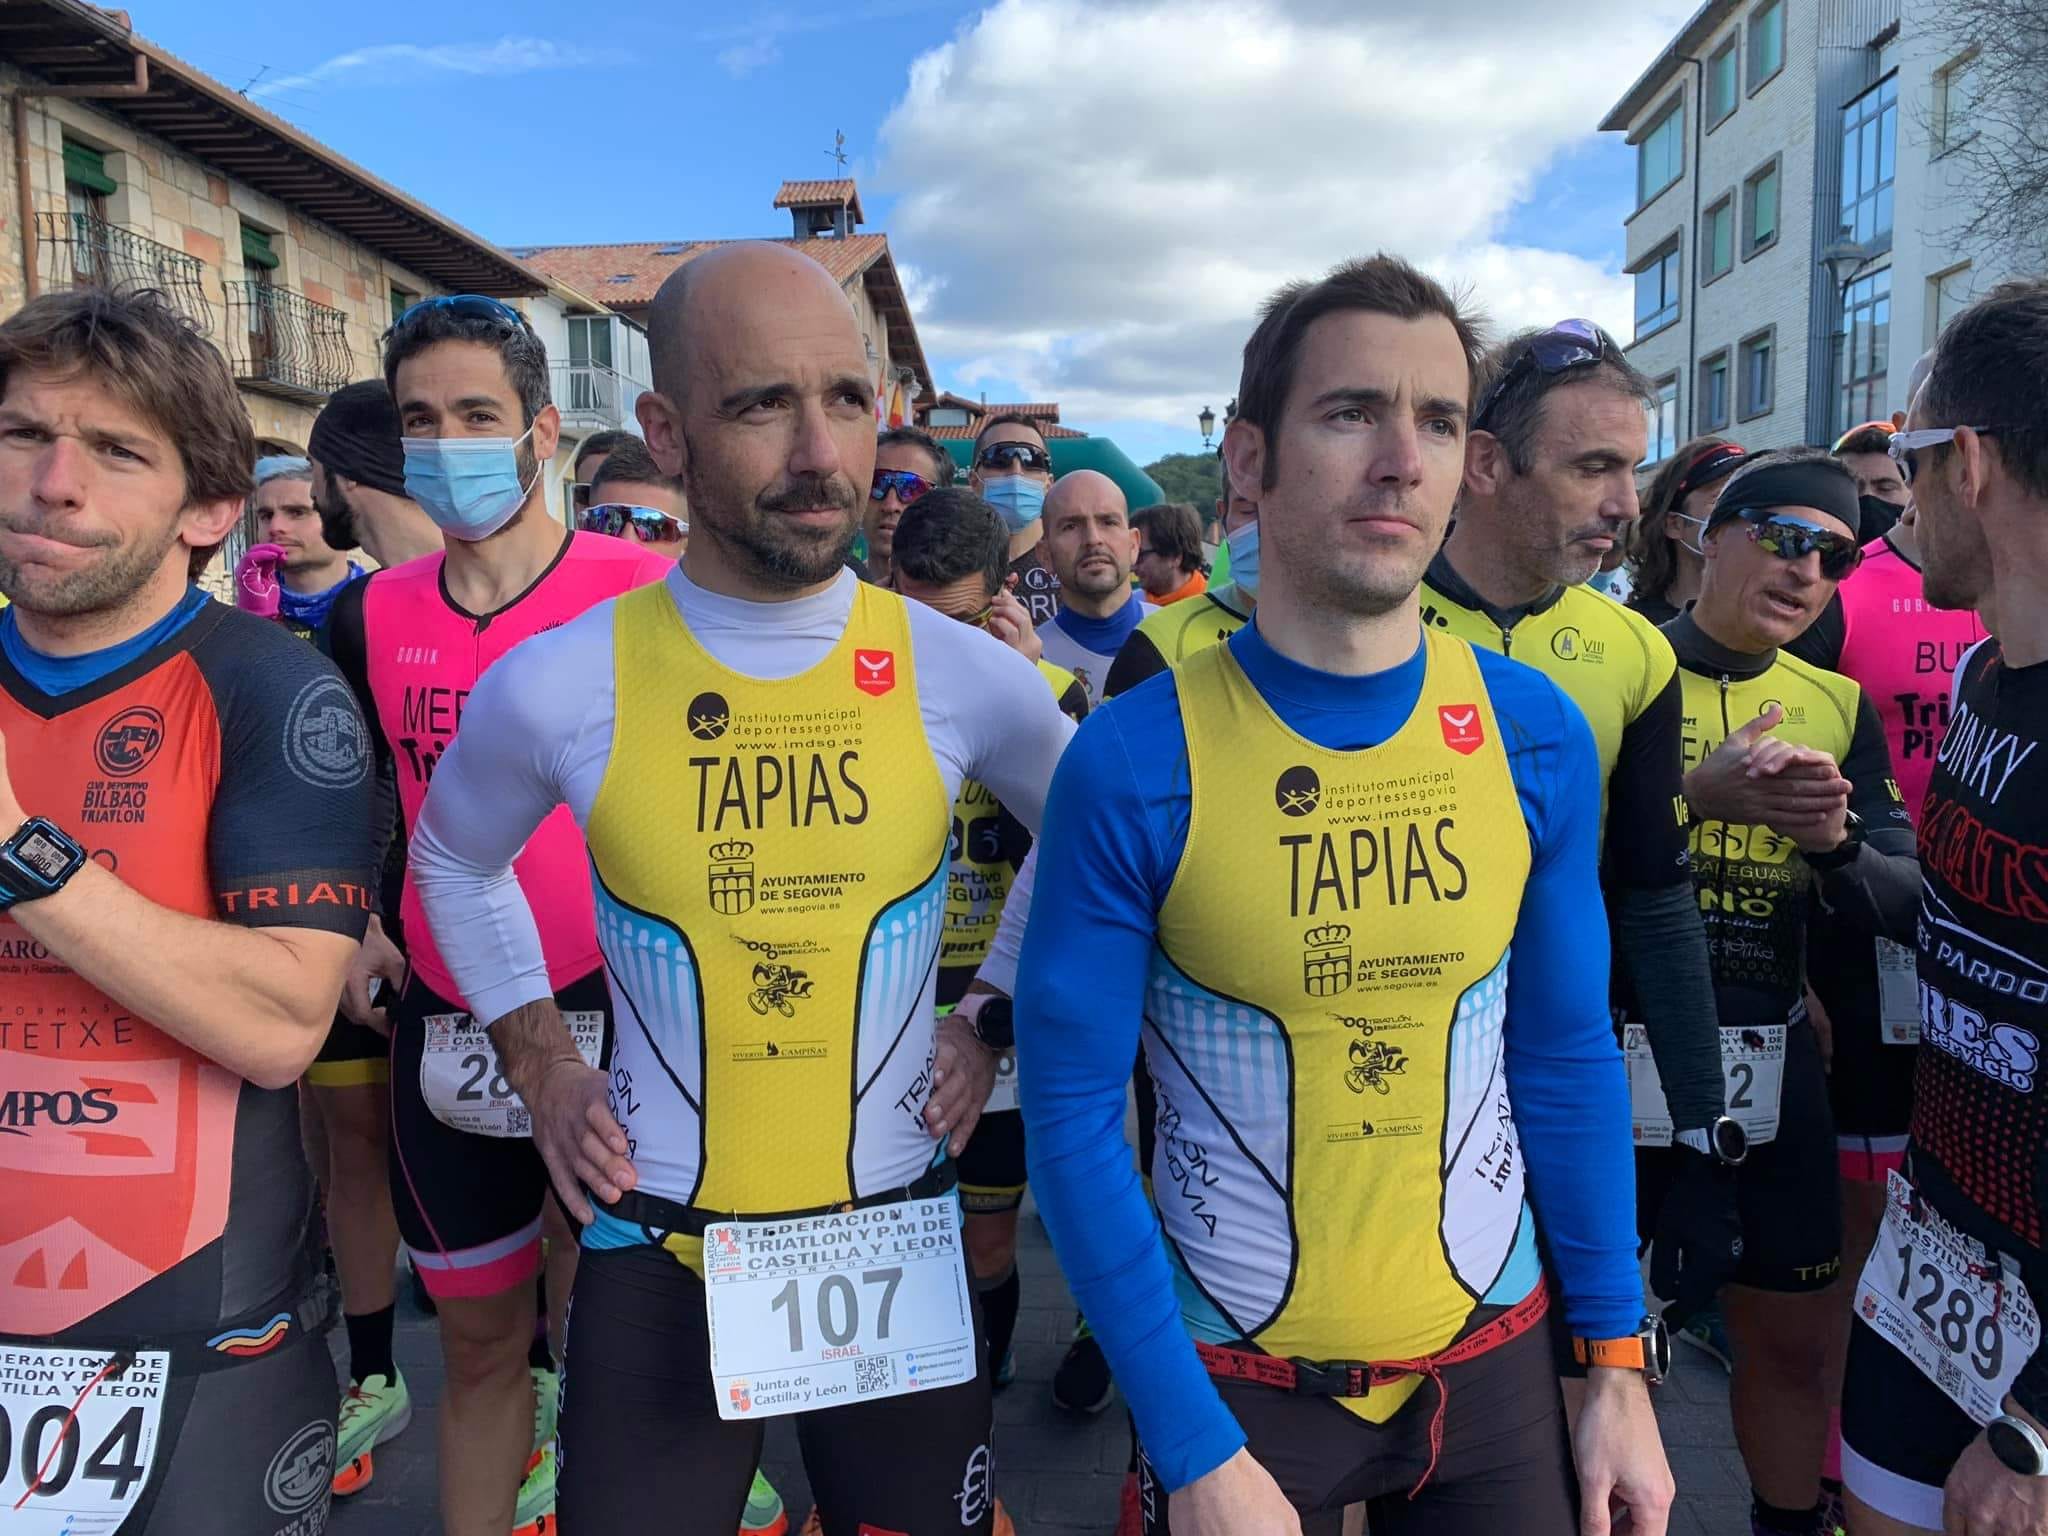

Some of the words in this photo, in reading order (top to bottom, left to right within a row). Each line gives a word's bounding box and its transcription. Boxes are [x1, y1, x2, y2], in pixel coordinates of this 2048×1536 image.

[1915, 641, 1976, 673] BU
[733, 722, 863, 737] deportessegovia
[735, 737, 863, 751] www.imdsg.es
[1902, 730, 1945, 760] Pi
[84, 790, 147, 808] BILBAO
[689, 750, 869, 832] TAPIAS
[1325, 785, 1457, 809] deportessegovia
[81, 810, 145, 823] TRIATLON
[1327, 802, 1458, 825] www.imdsg.es
[1279, 817, 1468, 917] TAPIAS
[760, 873, 866, 887] AYUNTAMIENTO
[760, 889, 779, 901] DE
[783, 887, 843, 899] SEGOVIA
[760, 902, 841, 914] www.segovia.es
[0, 939, 48, 959] ARO
[1358, 951, 1465, 970] AYUNTAMIENTO
[1357, 972, 1375, 981] DE
[1381, 967, 1442, 979] SEGOVIA
[1357, 980, 1438, 993] www.segovia.es
[894, 1048, 935, 1113] TRIA
[747, 1208, 903, 1239] FEDERACION
[921, 1202, 950, 1216] DE
[745, 1230, 857, 1253] TRIATLON
[858, 1228, 870, 1241] Y
[922, 1217, 953, 1233] DE
[747, 1247, 862, 1270] CASTILLA
[871, 1243, 883, 1256] Y
[893, 1233, 953, 1253] LEON
[771, 1266, 904, 1353] 107
[1897, 1243, 2004, 1380] 1289
[0, 1354, 112, 1368] ERACION
[132, 1358, 163, 1368] DE
[821, 1345, 864, 1361] ISRAEL
[62, 1371, 75, 1381] Y
[132, 1372, 161, 1383] DE
[753, 1377, 790, 1393] Junta
[793, 1375, 810, 1386] de
[96, 1386, 157, 1398] LEON
[754, 1388, 800, 1406] Castilla
[804, 1391, 812, 1401] y
[816, 1382, 847, 1397] León
[0, 1404, 145, 1501] 04
